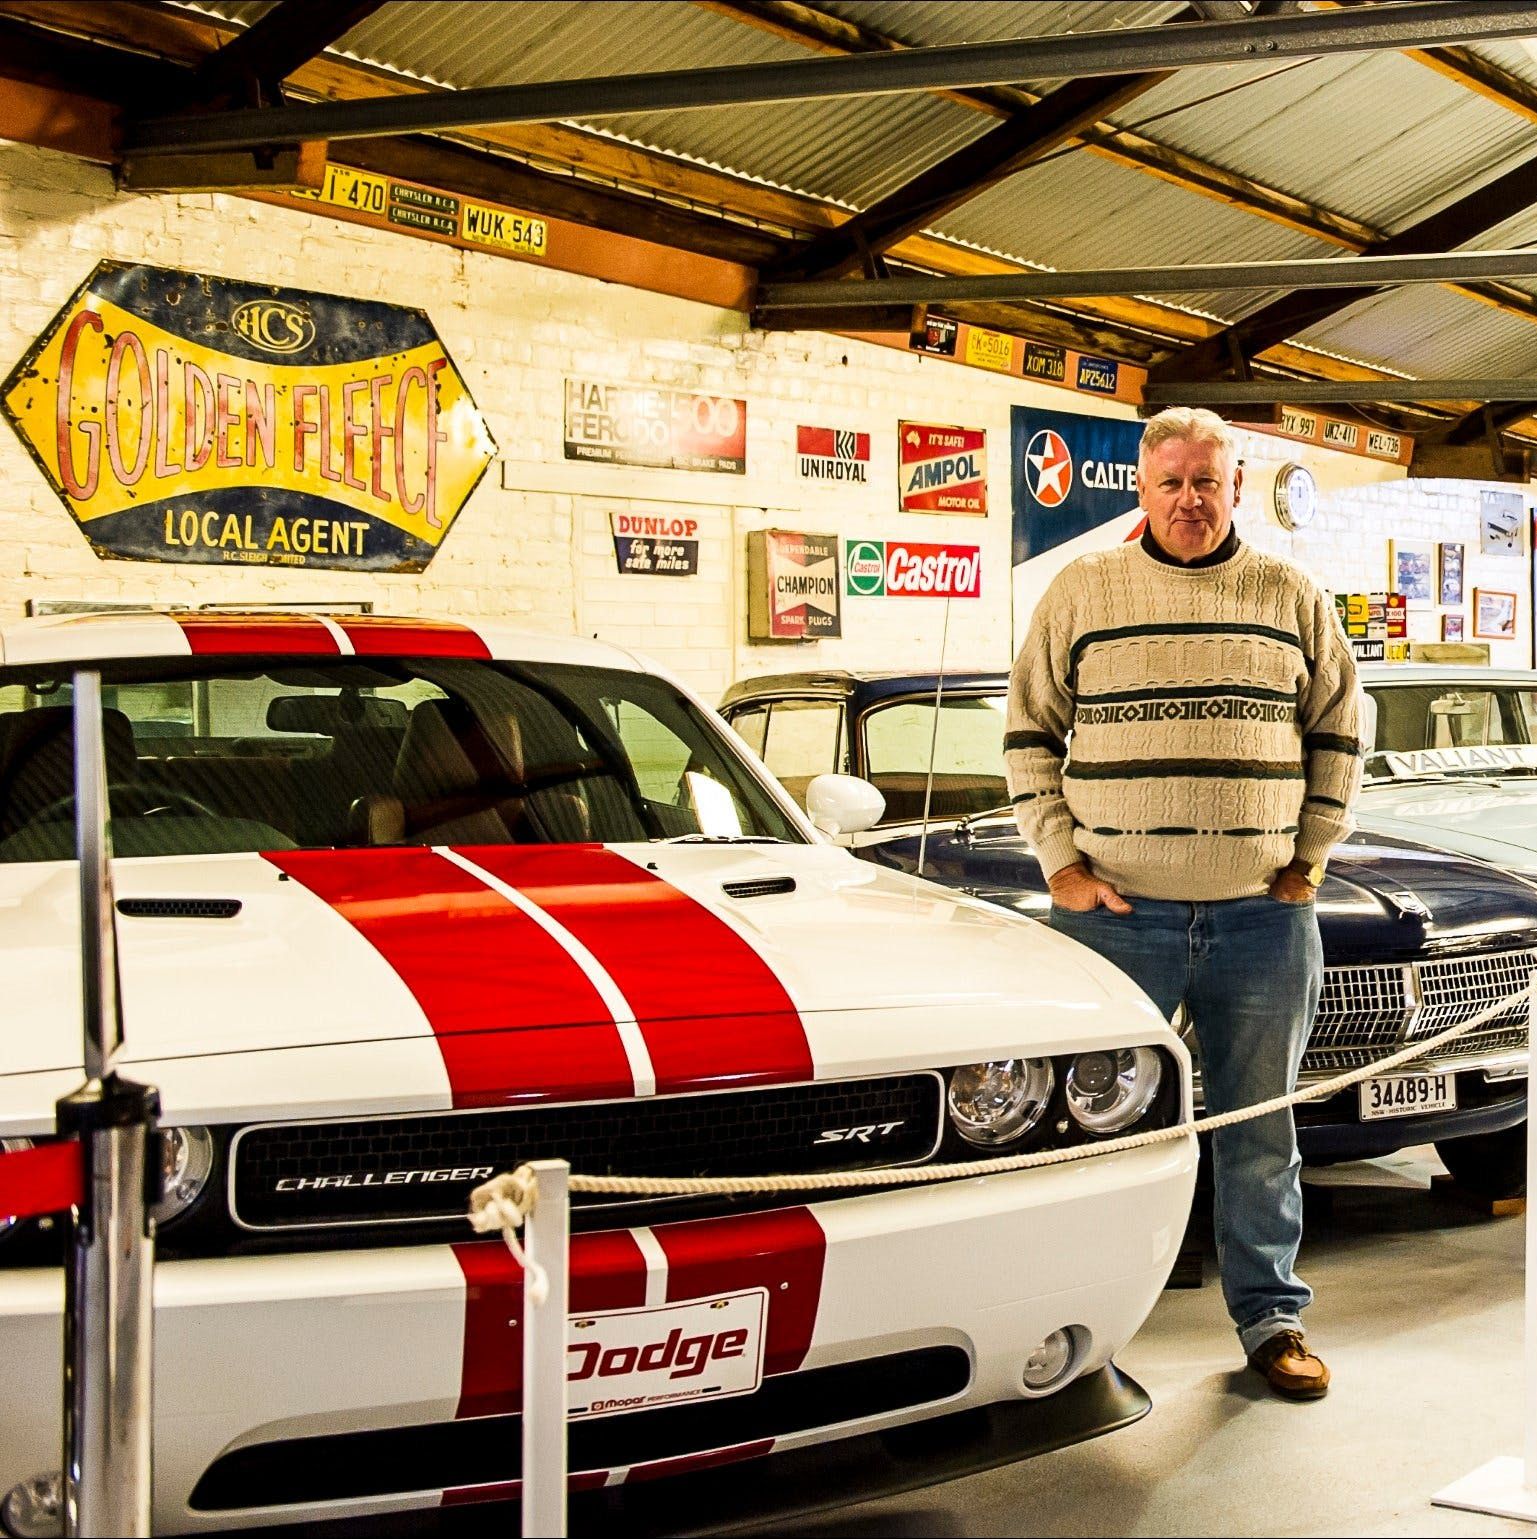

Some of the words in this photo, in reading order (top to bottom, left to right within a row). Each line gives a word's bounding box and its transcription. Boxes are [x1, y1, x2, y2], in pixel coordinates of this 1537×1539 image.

[568, 380, 660, 419] HARIE
[56, 310, 276, 502] GOLDEN
[293, 357, 448, 528] FLEECE
[801, 457, 867, 482] UNIROYAL
[907, 454, 981, 492] AMPOL
[1081, 459, 1140, 492] CALTE
[938, 496, 966, 508] MOTOR
[967, 497, 981, 509] OIL
[165, 509, 259, 549] LOCAL
[266, 516, 370, 556] AGENT
[618, 515, 698, 536] DUNLOP
[630, 539, 650, 555] for
[653, 545, 685, 557] more
[779, 544, 829, 556] DEPENDABLE
[625, 556, 652, 570] safe
[655, 555, 690, 570] miles
[854, 561, 881, 574] Castrol
[886, 547, 980, 593] Castrol
[776, 575, 834, 596] CHAMPION
[780, 615, 806, 626] SPARK
[808, 615, 833, 627] PLUGS
[1394, 747, 1523, 773] VALIANT
[1388, 1105, 1417, 1115] HISTORIC
[1420, 1101, 1446, 1111] VEHICLE
[813, 1120, 905, 1145] SRT
[275, 1165, 493, 1191] CHALLENGER
[567, 1327, 748, 1382] Dodge
[647, 1388, 701, 1402] PERFORMANCE
